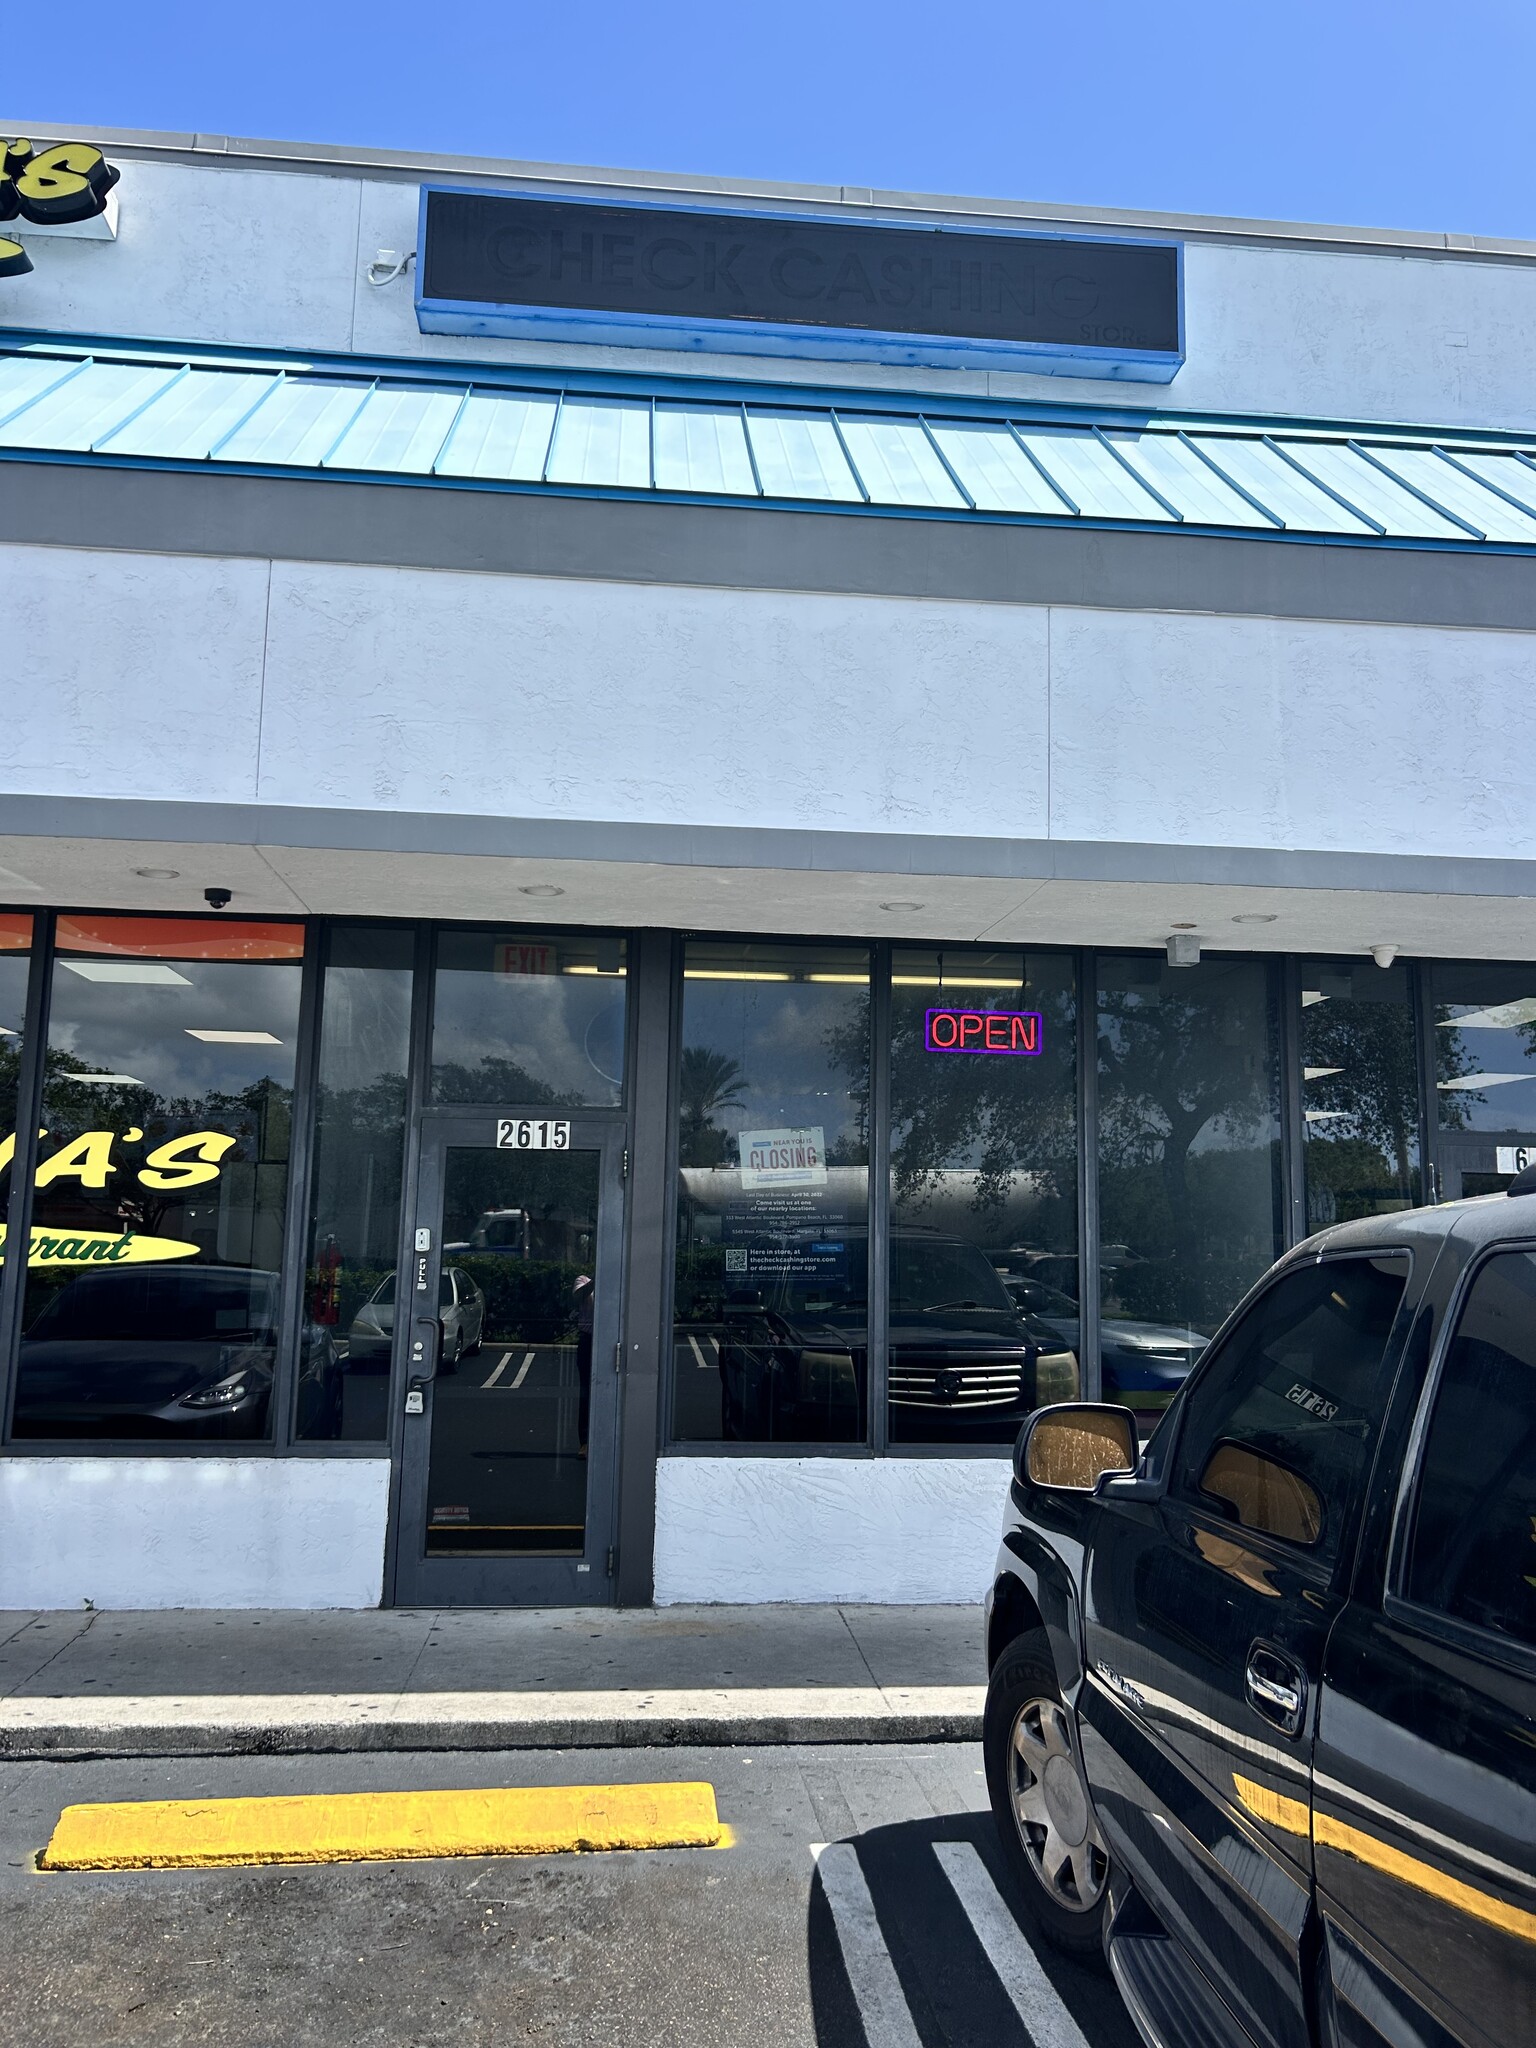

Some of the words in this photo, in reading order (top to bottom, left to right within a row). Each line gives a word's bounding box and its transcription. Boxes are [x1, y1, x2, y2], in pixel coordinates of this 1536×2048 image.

[486, 224, 746, 297] CHECK
[769, 246, 1100, 320] CASHING
[504, 946, 550, 979] EXIT
[931, 1013, 1036, 1051] OPEN
[499, 1120, 567, 1149] 2615
[750, 1146, 817, 1169] CLOSING
[418, 1258, 426, 1282] PULL
